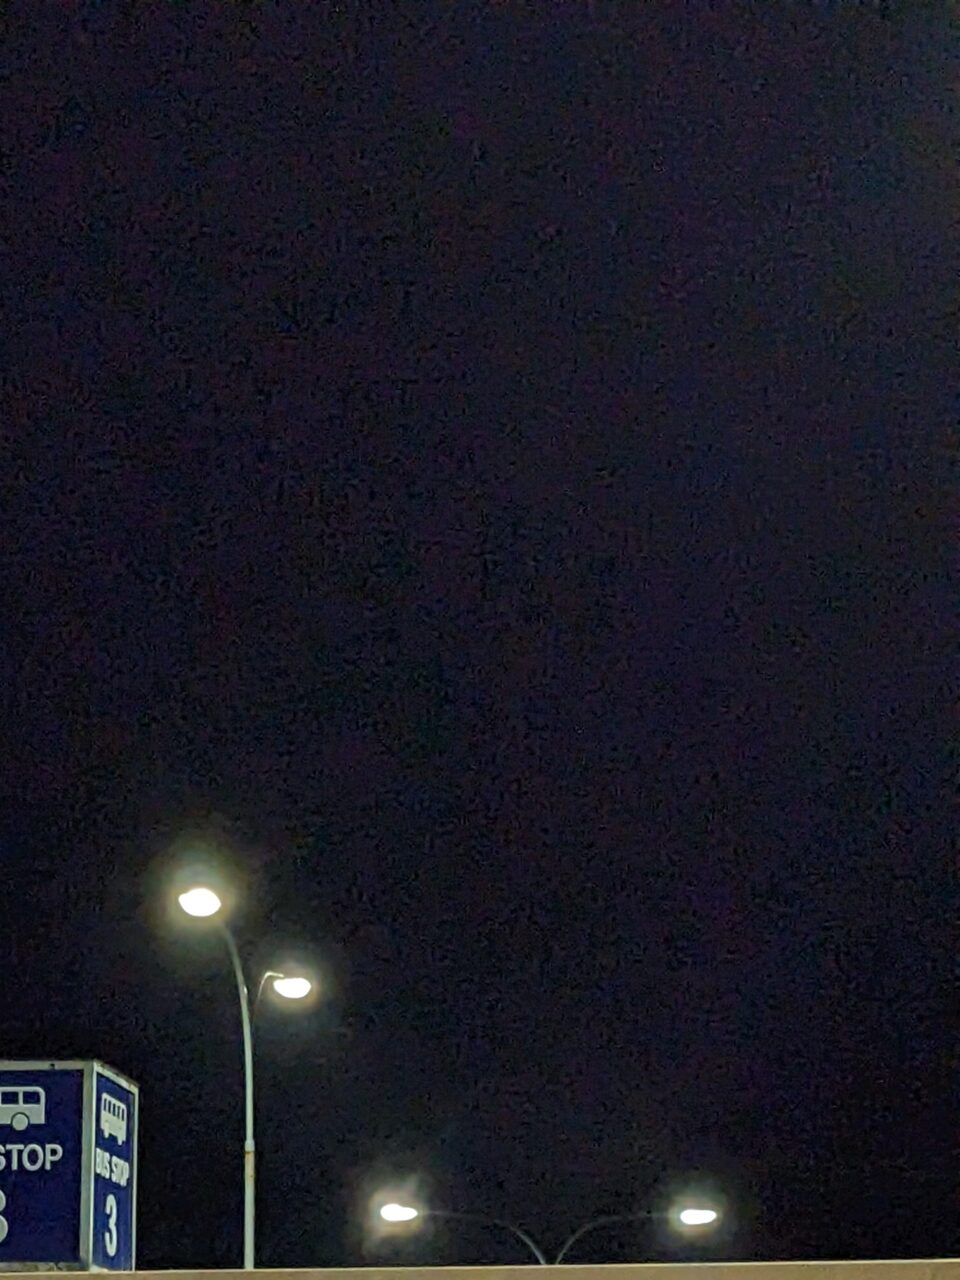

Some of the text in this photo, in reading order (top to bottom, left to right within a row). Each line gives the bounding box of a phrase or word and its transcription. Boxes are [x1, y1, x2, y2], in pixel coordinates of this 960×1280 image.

[95, 1147, 130, 1187] BUS STOP
[104, 1194, 118, 1257] 3
